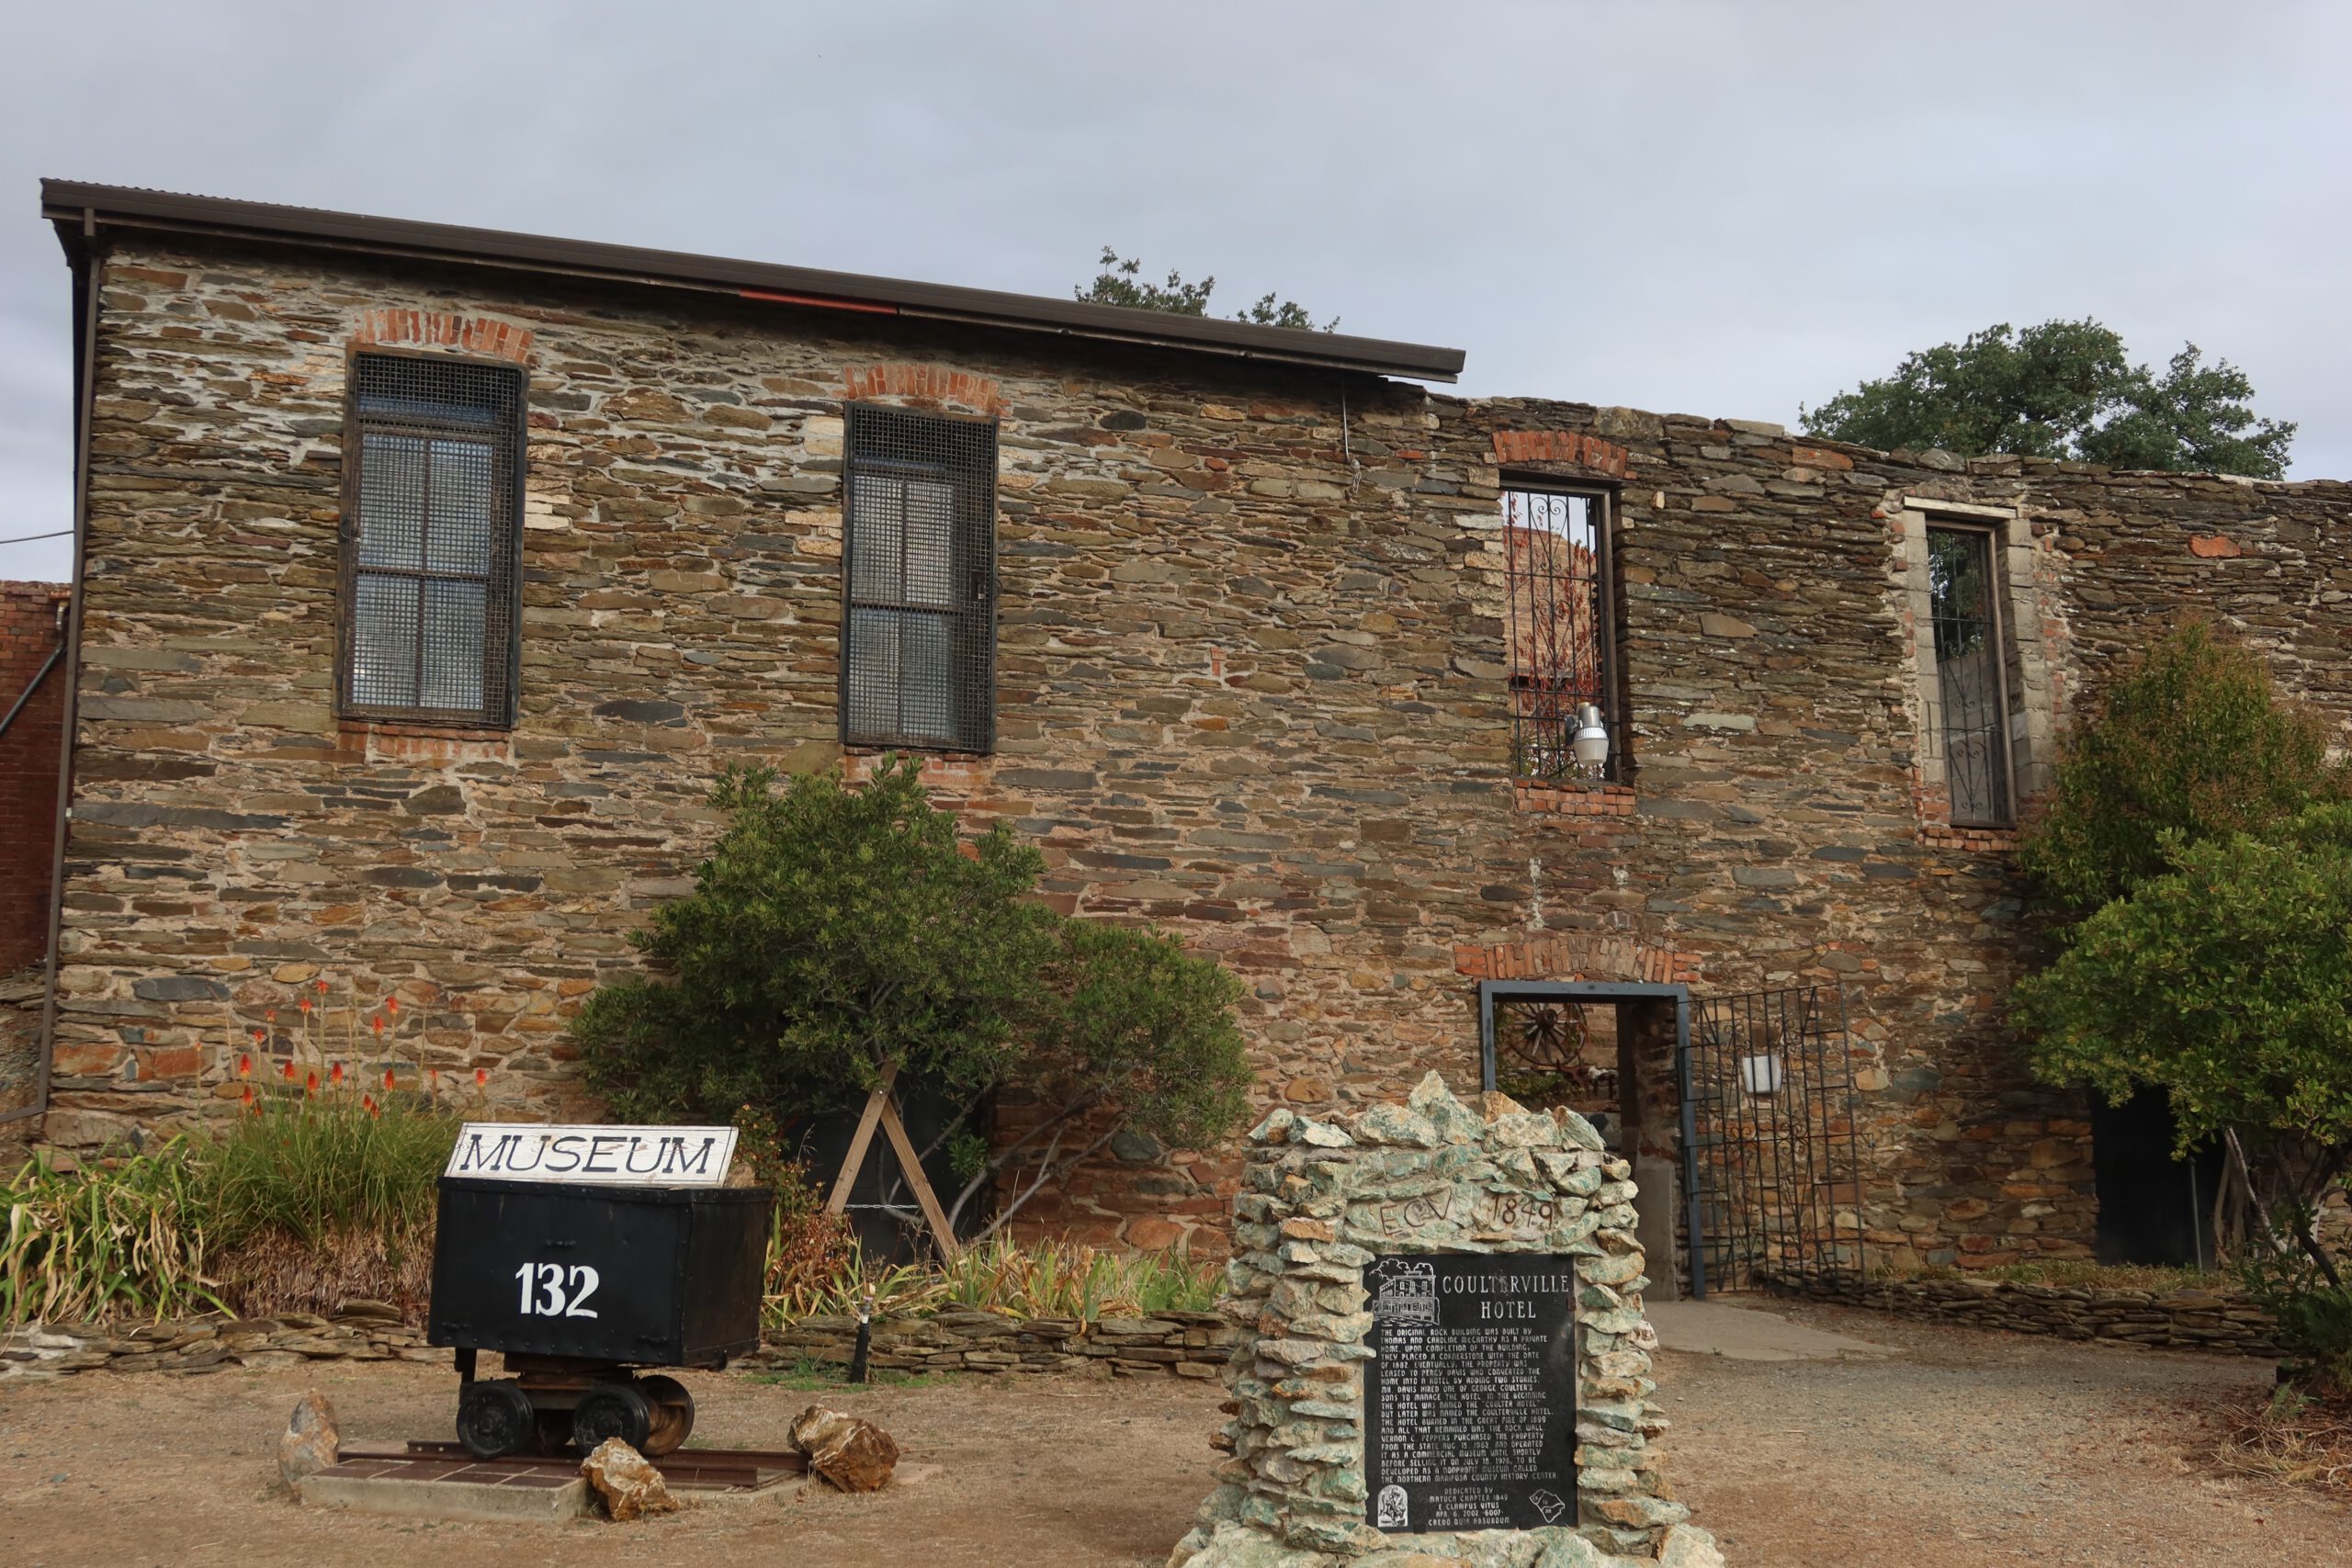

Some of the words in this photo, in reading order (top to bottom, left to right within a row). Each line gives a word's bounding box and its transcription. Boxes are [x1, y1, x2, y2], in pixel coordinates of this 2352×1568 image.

[459, 1134, 716, 1174] MUSEUM
[1491, 1193, 1554, 1230] 1849
[515, 1262, 599, 1319] 132
[1442, 1275, 1569, 1294] COULTERVILLE
[1481, 1301, 1537, 1319] HOTEL
